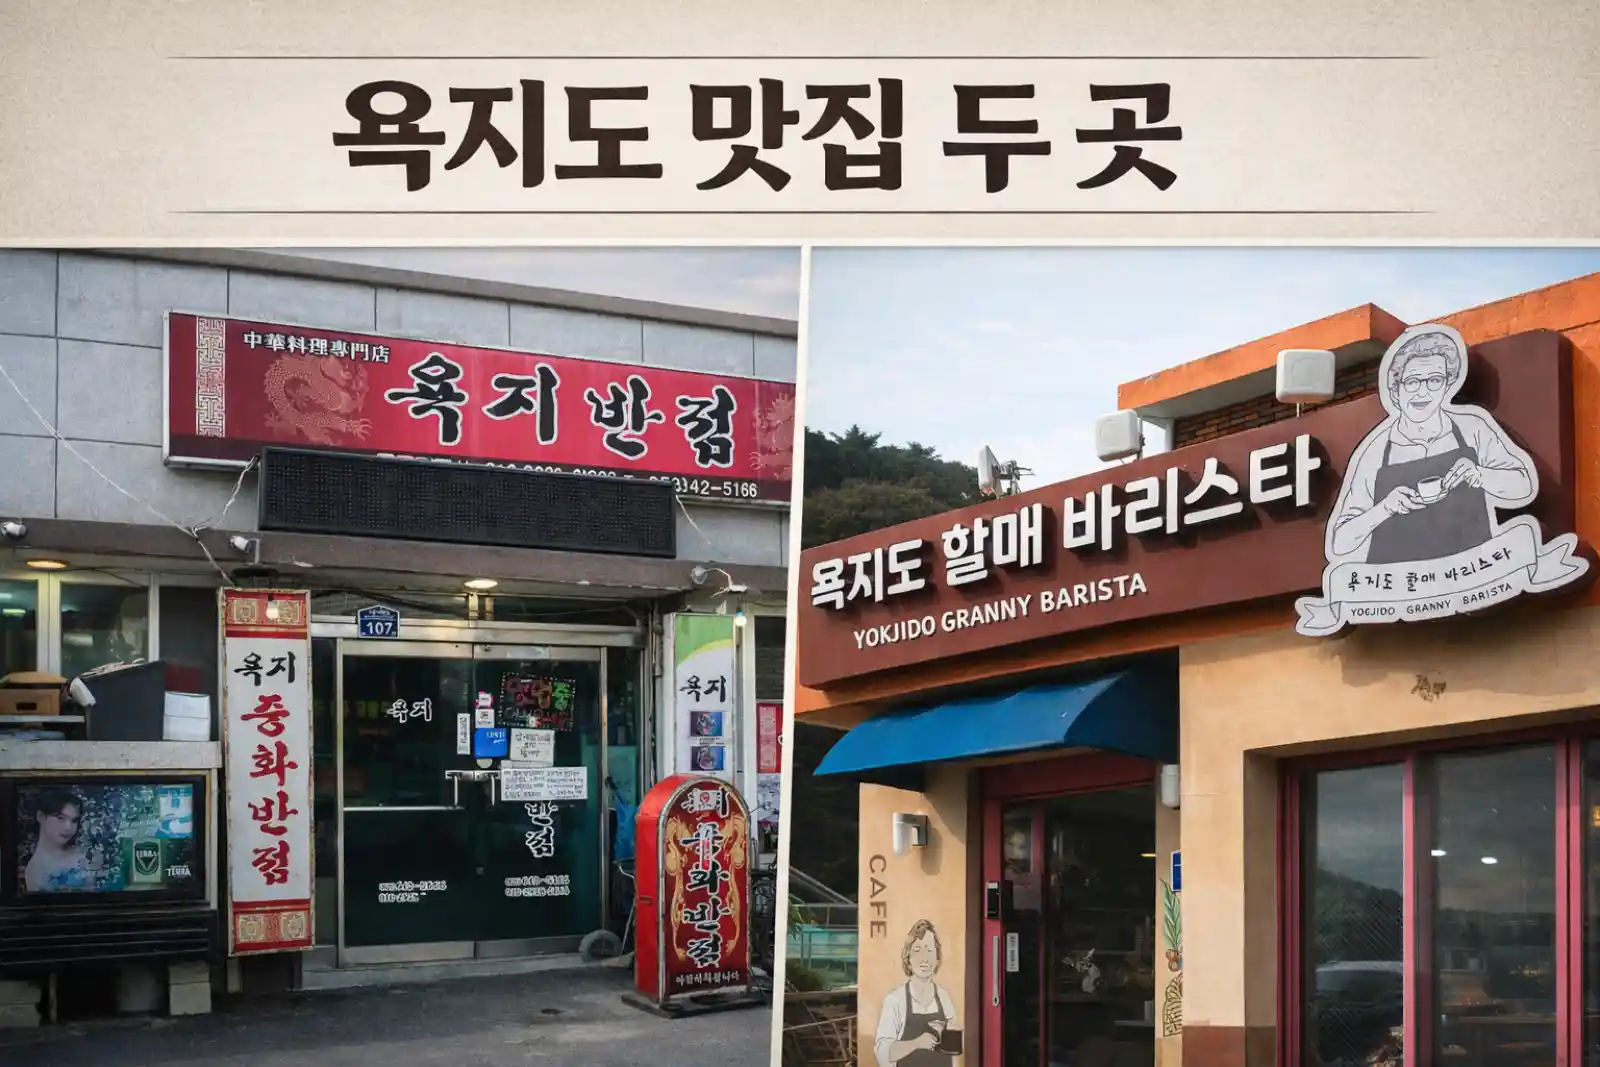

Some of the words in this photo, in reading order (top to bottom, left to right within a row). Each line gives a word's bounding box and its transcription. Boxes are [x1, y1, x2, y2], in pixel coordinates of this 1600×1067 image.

[243, 330, 390, 363] 中華料理專門店
[384, 350, 738, 470] 욕지반점
[810, 538, 925, 609] 욕지도
[942, 502, 1044, 588] 할매
[1062, 433, 1322, 552] 바리스타
[1348, 571, 1393, 593] 욕지도
[1444, 547, 1512, 581] 바리스타
[853, 615, 936, 650] YOKJIDO
[941, 594, 1033, 631] GRANNY
[1040, 572, 1148, 614] BARISTA
[1406, 599, 1451, 615] GRANNY
[1462, 582, 1513, 605] BARISTA
[366, 621, 393, 635] 107
[233, 651, 297, 687] 욕지
[680, 674, 727, 703] 욕지
[387, 697, 433, 723] 욕지
[240, 693, 299, 885] 중화반점
[868, 853, 888, 939] CAFE
